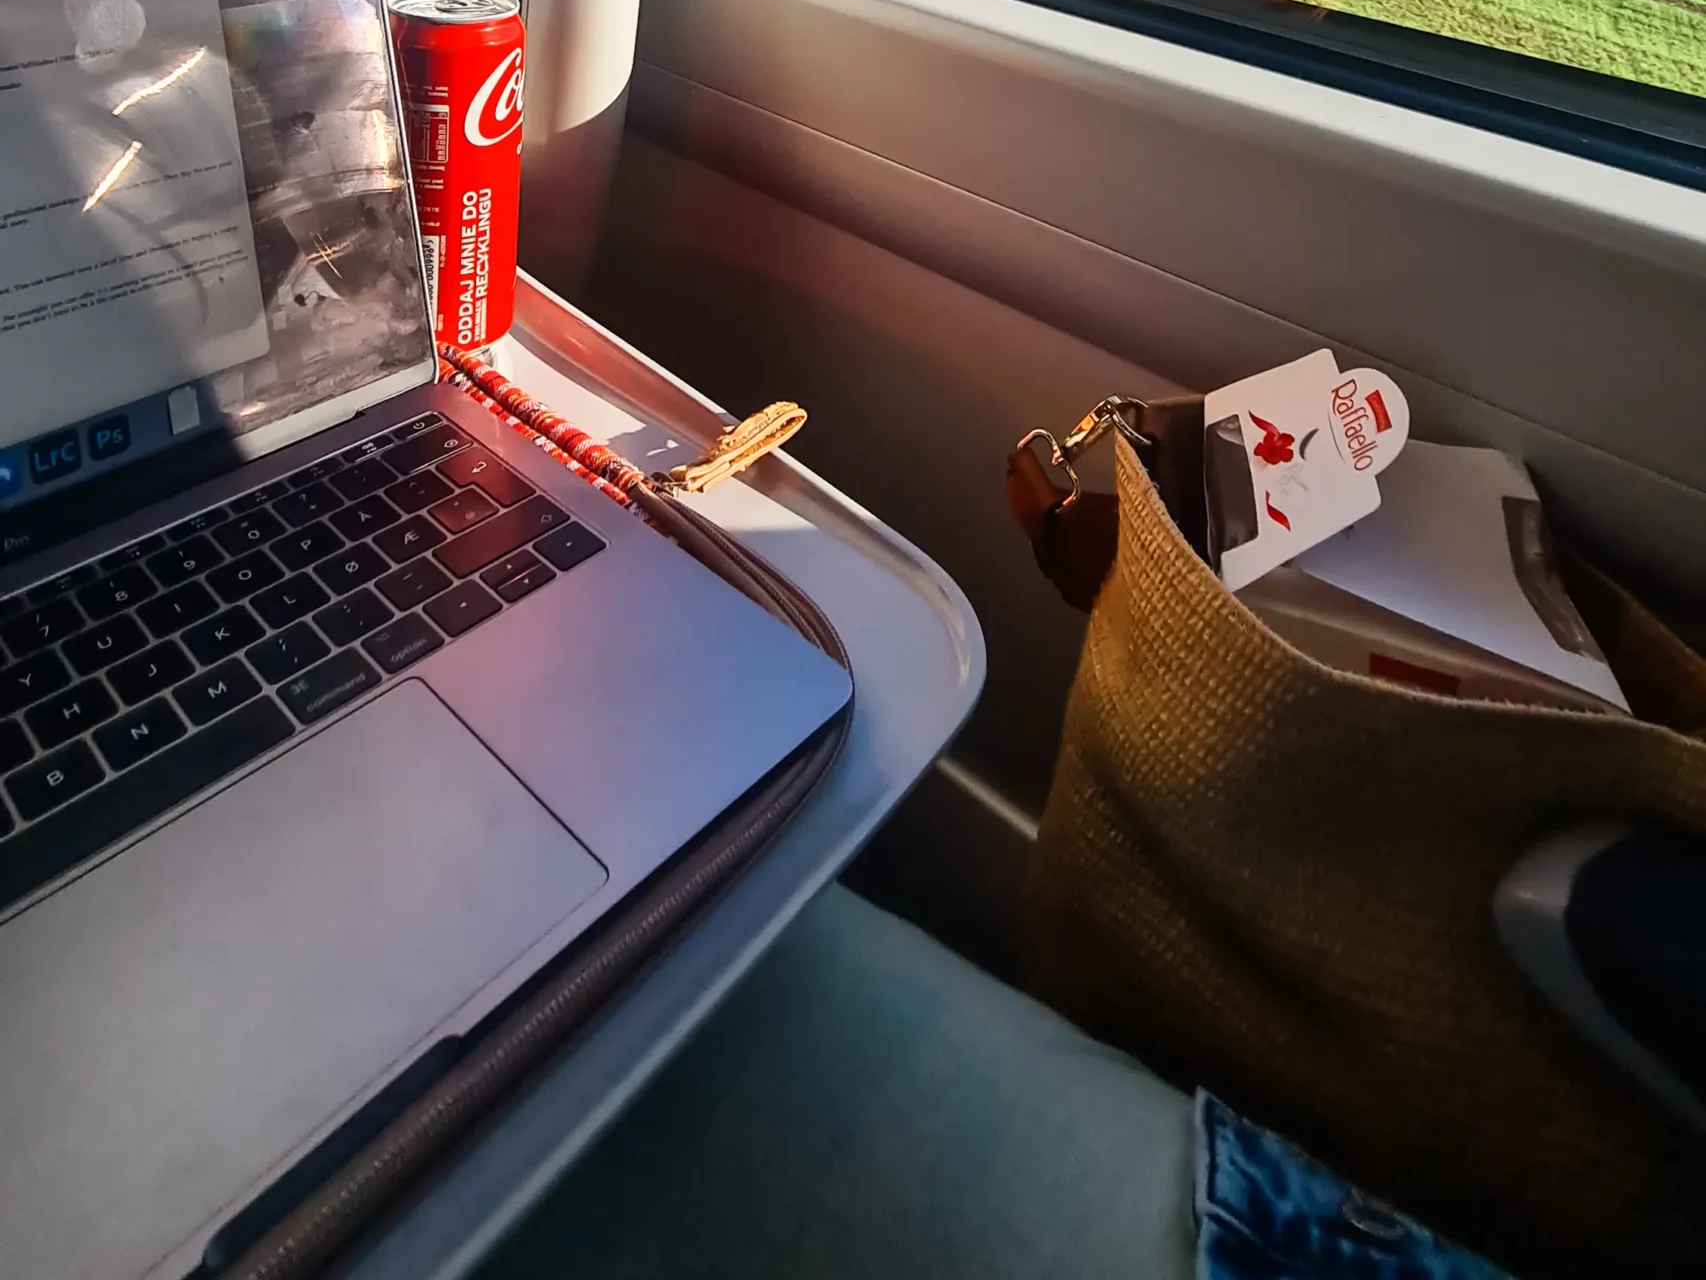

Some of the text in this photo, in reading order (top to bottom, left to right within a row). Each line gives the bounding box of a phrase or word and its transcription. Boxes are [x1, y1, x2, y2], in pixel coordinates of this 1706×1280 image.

[475, 188, 492, 298] RECYKLINGU
[457, 191, 478, 345] ODDAJ MNIE DO
[1331, 378, 1379, 472] Raffaello
[34, 428, 124, 474] LrC Ps
[300, 539, 312, 551] P
[404, 530, 419, 545] Æ
[183, 560, 196, 570] 9
[345, 560, 359, 574] Ø
[115, 591, 128, 602] 8
[282, 594, 297, 605] L
[39, 625, 50, 638] 7
[214, 627, 230, 641] K
[96, 636, 113, 650] U
[390, 637, 429, 663] option
[147, 663, 158, 677] J
[18, 673, 32, 687] Y
[207, 681, 227, 699] M
[305, 671, 367, 713] command
[62, 702, 81, 720] H
[130, 723, 149, 740] N
[46, 770, 64, 787] B
